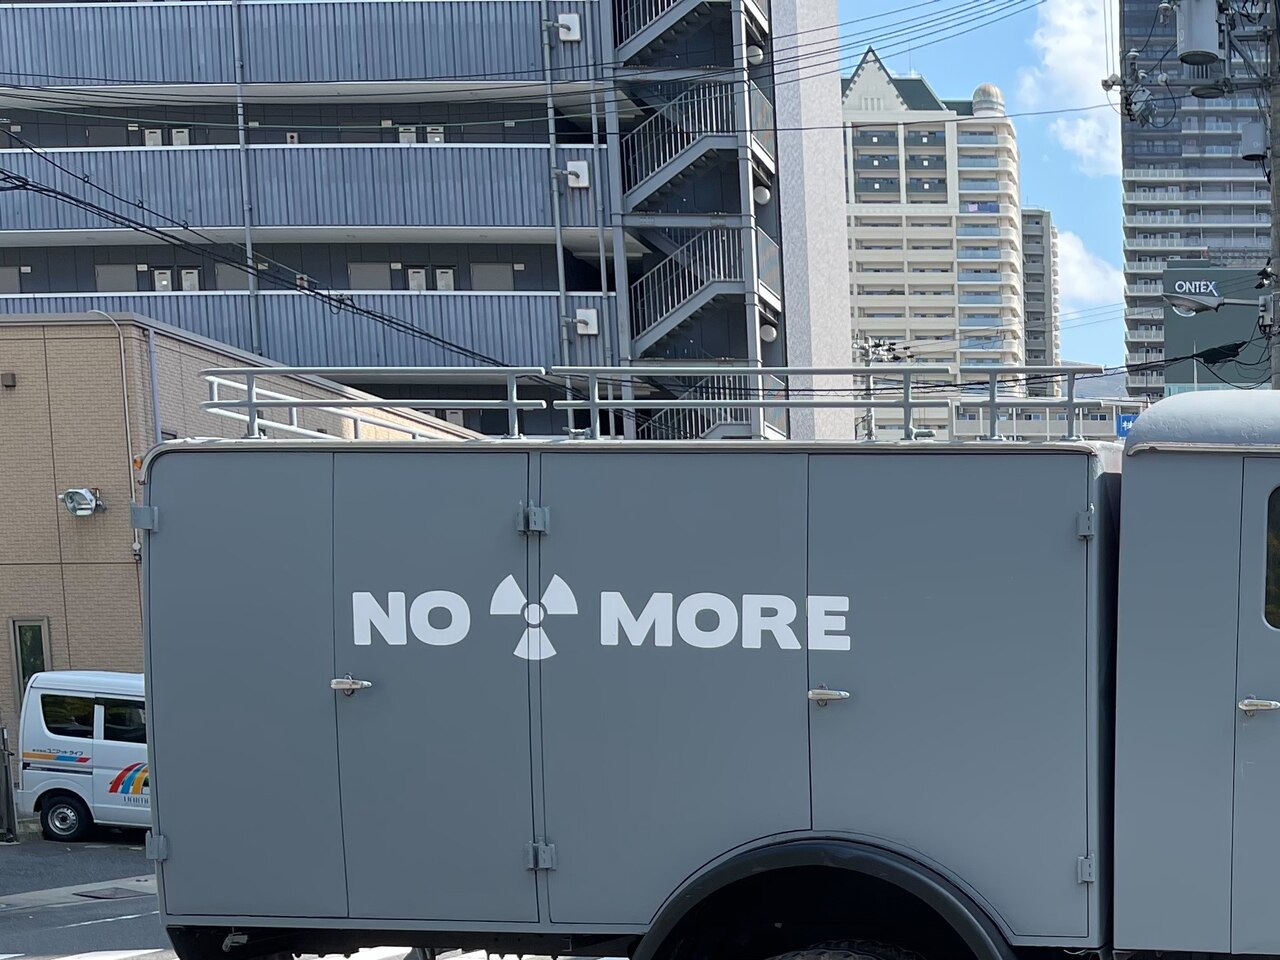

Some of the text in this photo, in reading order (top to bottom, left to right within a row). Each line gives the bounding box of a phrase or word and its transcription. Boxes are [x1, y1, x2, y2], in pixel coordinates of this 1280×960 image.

[1175, 280, 1218, 297] ONTEX
[352, 590, 851, 650] NO MORE
